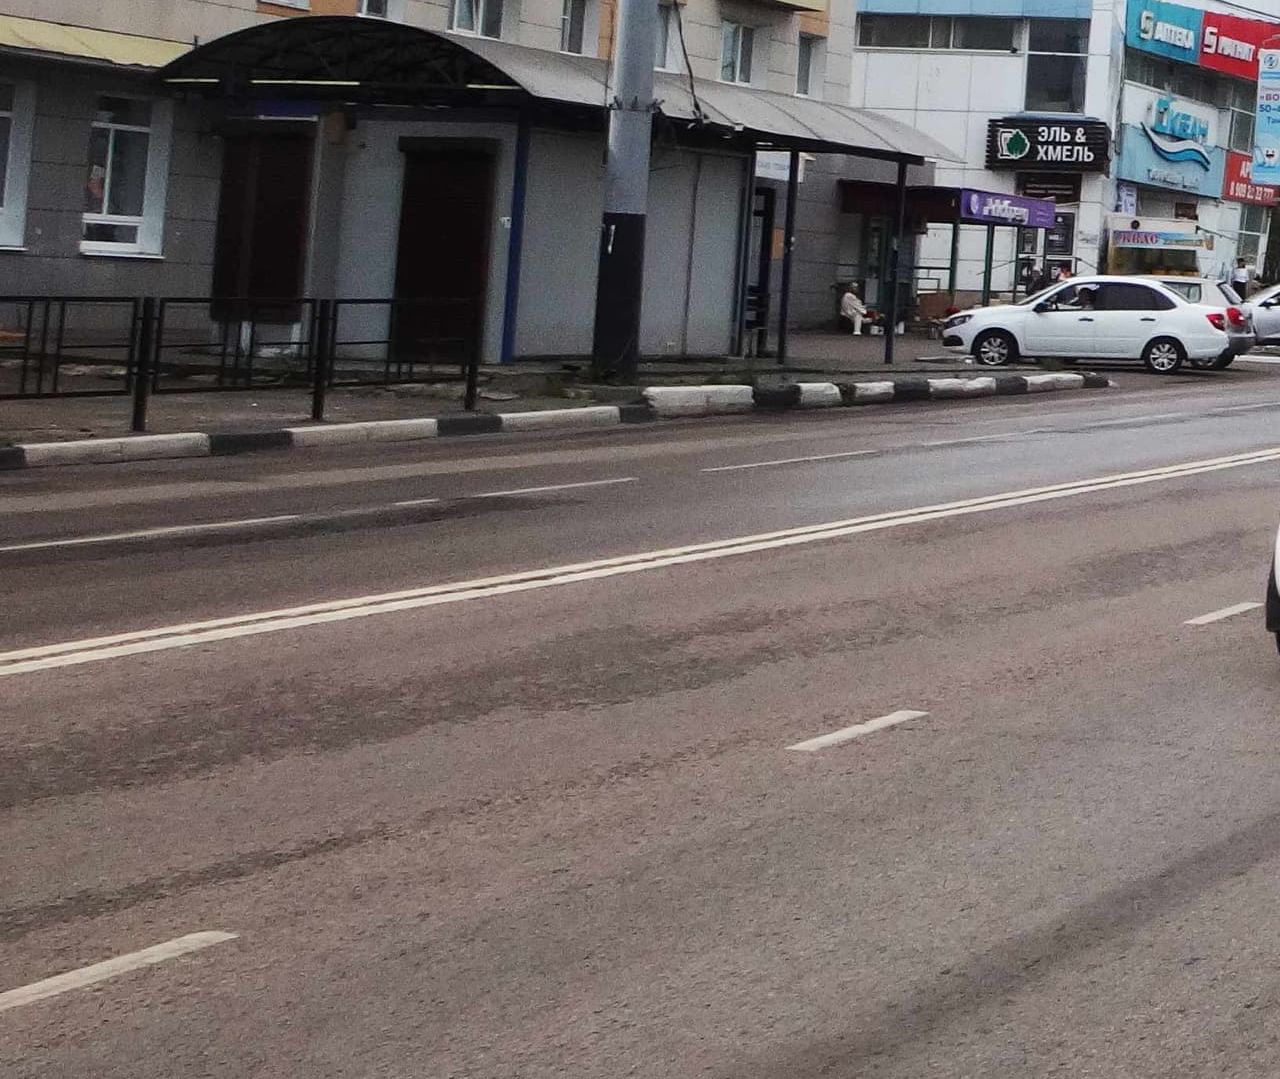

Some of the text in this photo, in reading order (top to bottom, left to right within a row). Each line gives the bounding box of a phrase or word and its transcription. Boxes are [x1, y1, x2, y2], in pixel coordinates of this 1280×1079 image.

[1038, 126, 1087, 143] ЭЛЬ &
[1037, 145, 1095, 162] ХМЕЛЬ
